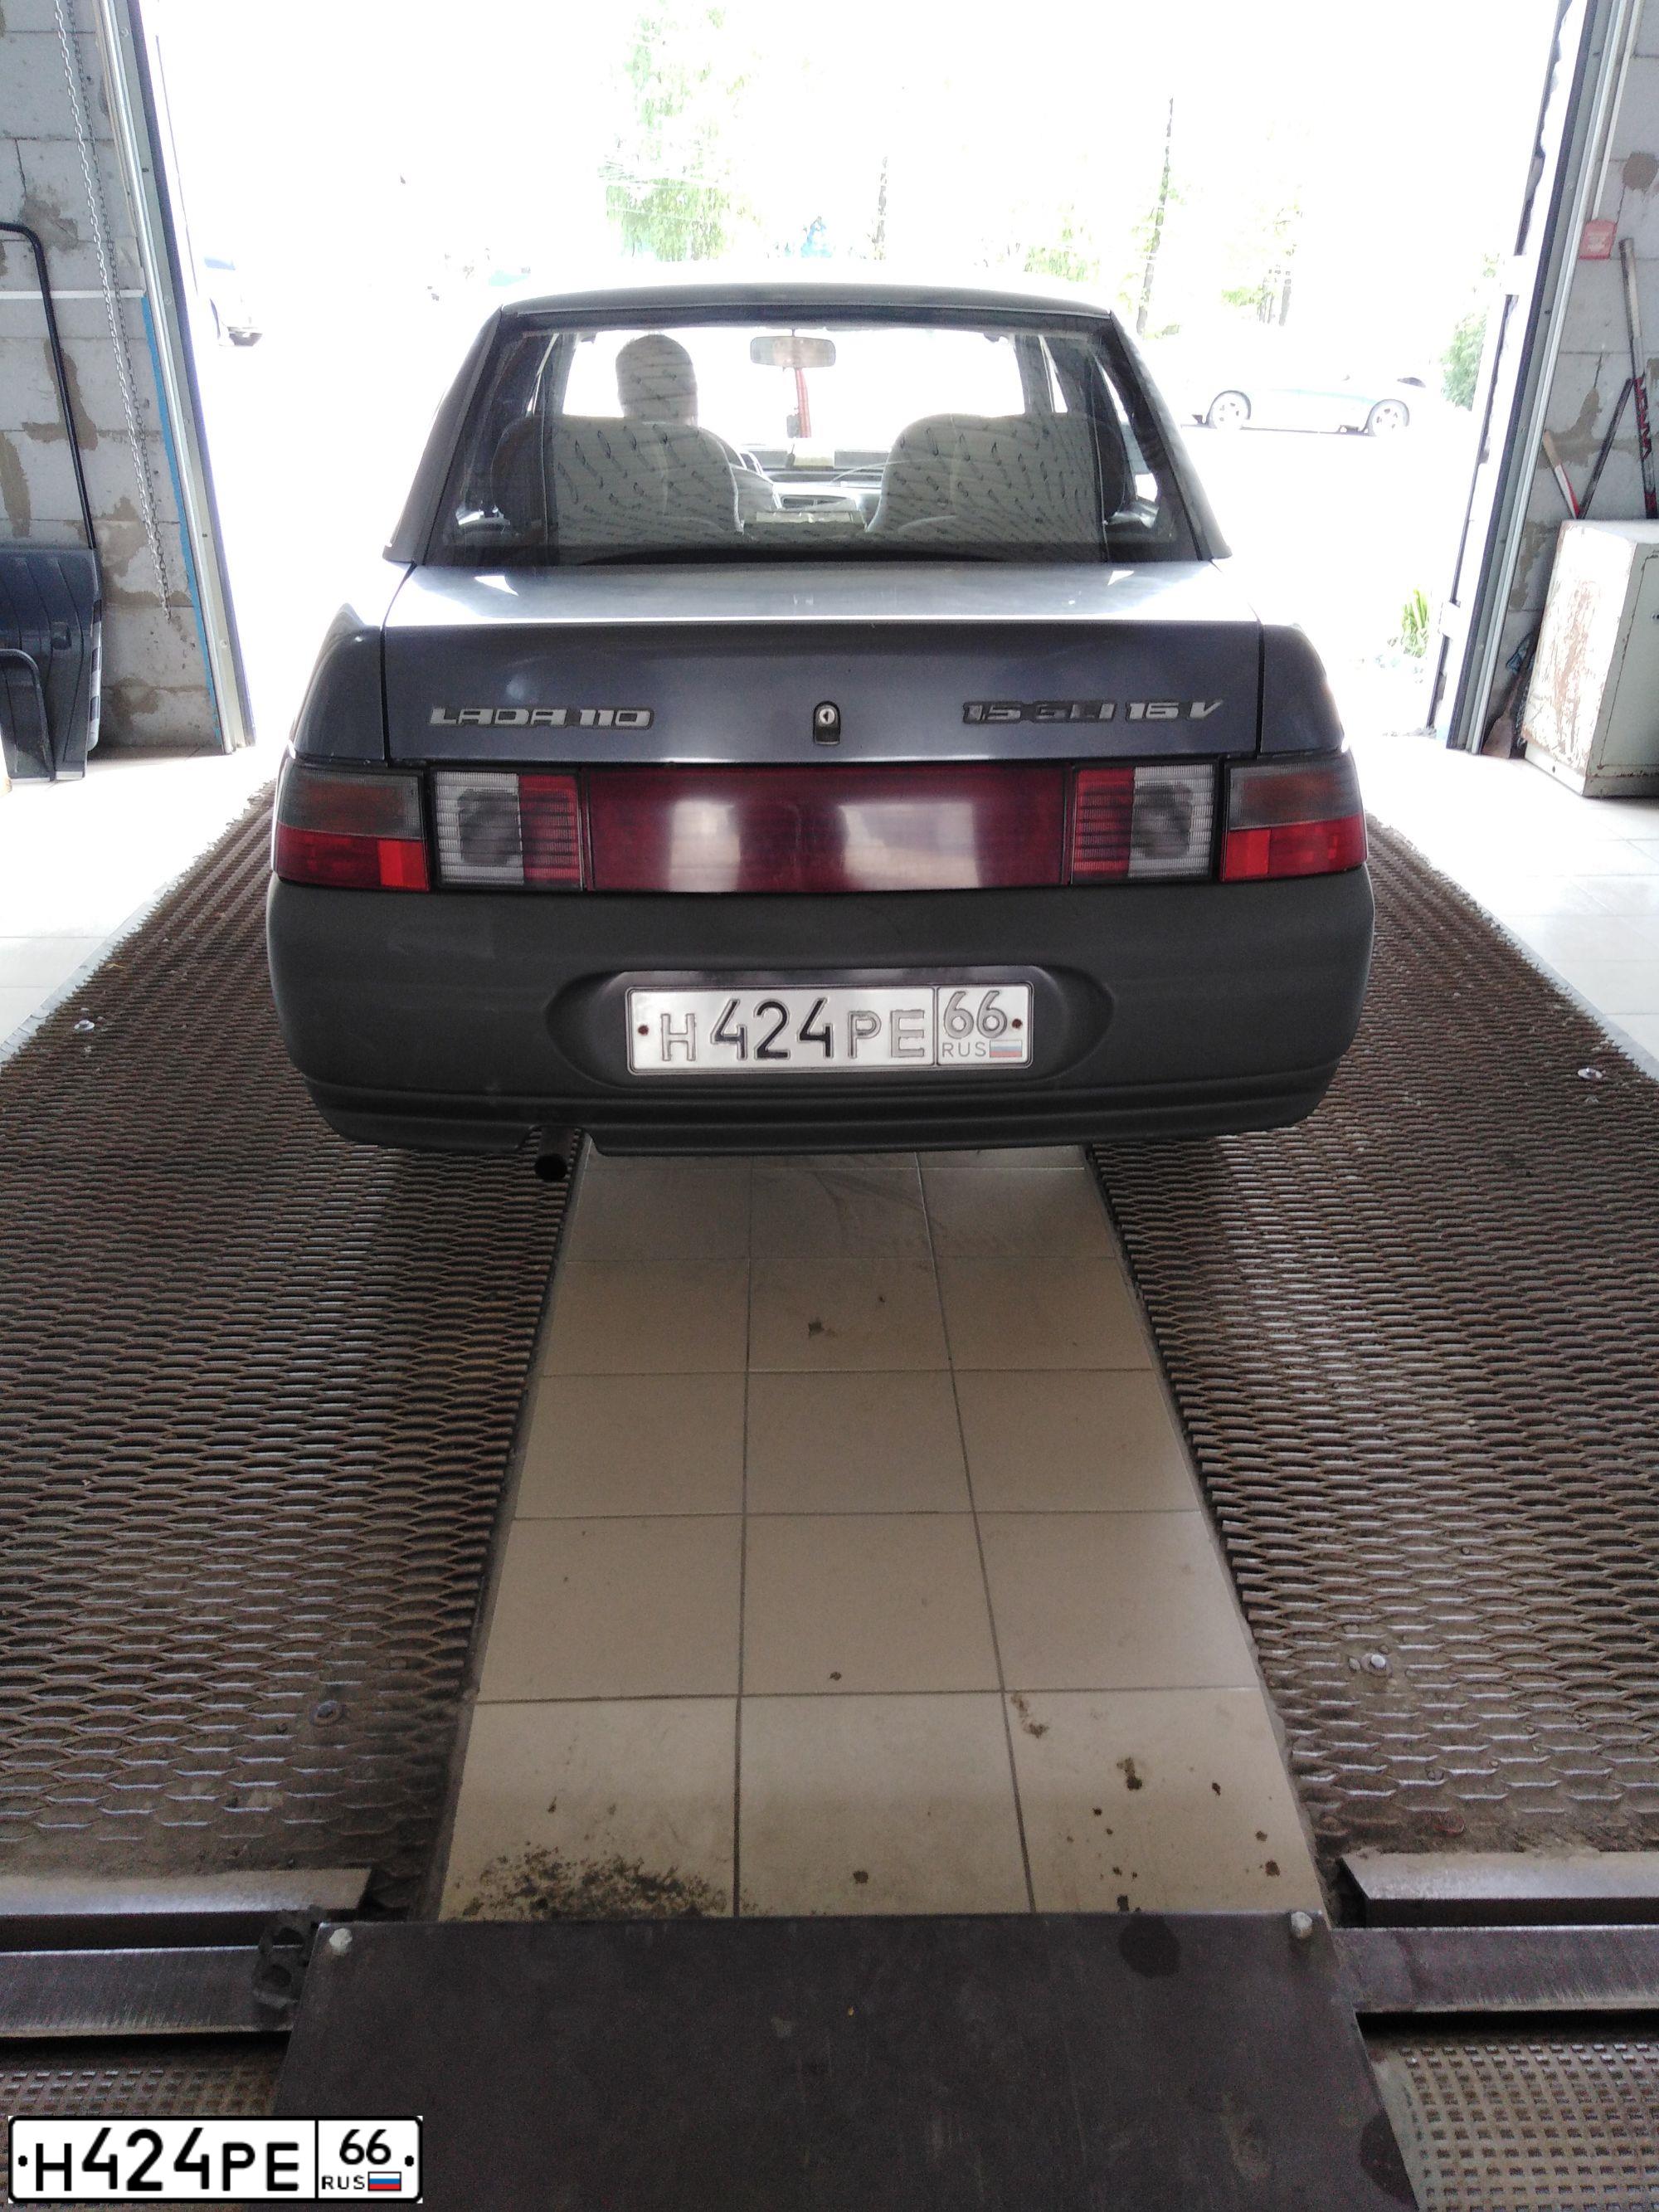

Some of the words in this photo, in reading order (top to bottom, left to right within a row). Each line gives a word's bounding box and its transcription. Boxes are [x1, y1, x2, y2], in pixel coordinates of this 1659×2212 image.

[430, 707, 567, 726] LADA
[580, 708, 653, 728] 110
[1127, 701, 1180, 720] 16
[1186, 699, 1224, 719] V
[942, 991, 1008, 1040] 66
[941, 1043, 987, 1059] RUS
